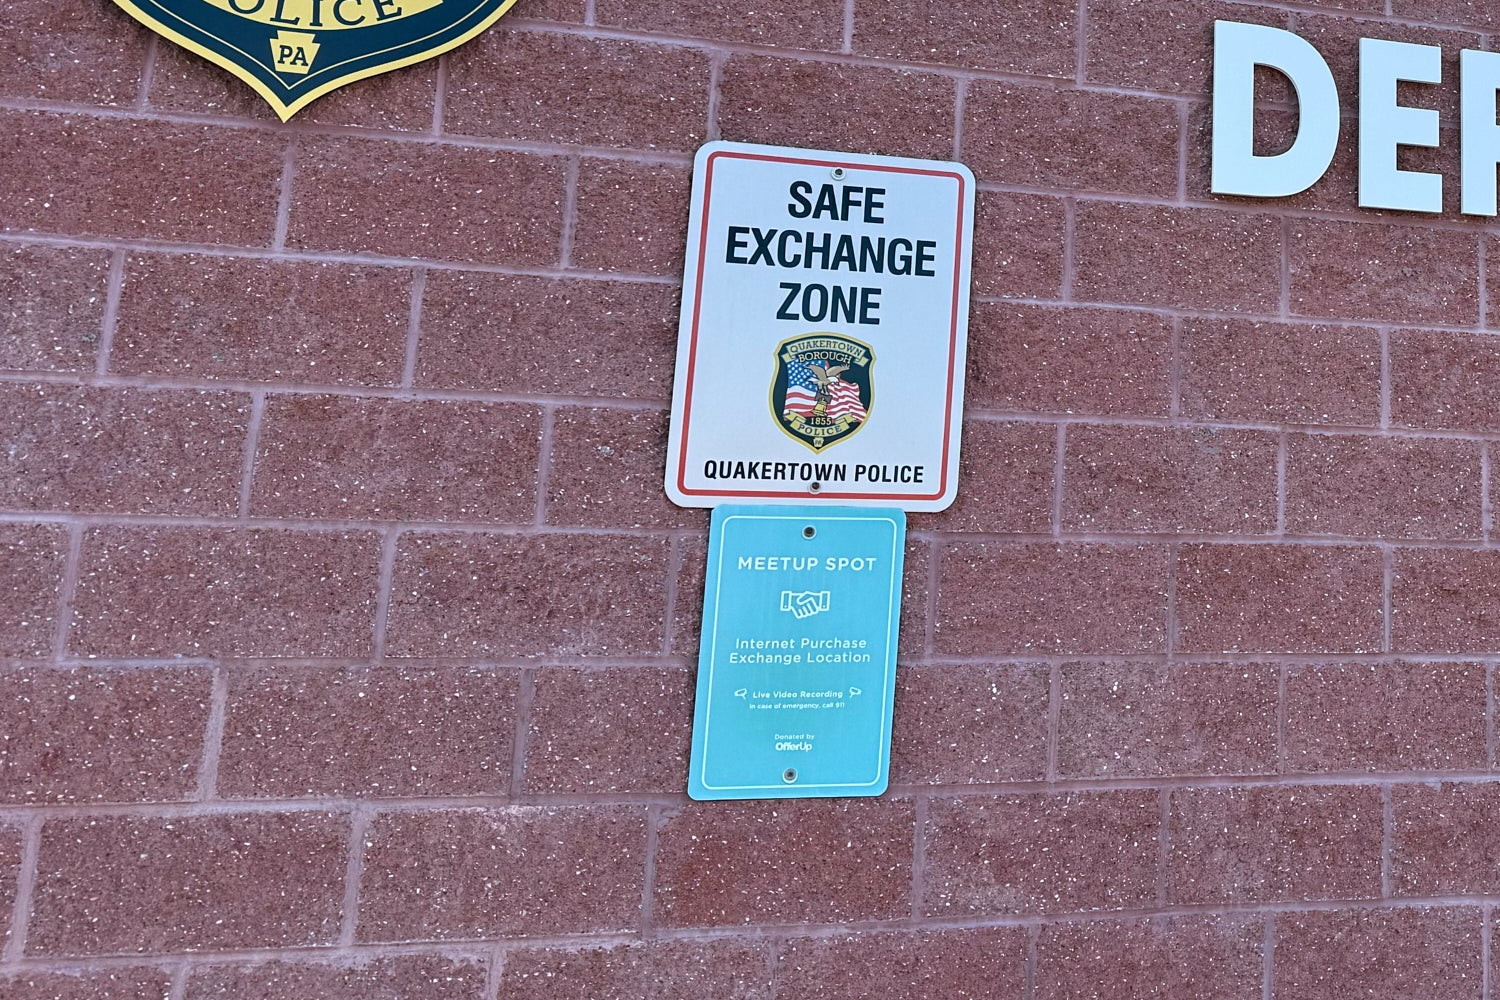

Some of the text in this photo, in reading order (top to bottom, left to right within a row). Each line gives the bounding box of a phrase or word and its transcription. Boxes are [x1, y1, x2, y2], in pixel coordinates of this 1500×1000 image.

[277, 43, 310, 68] PA
[787, 180, 886, 224] SAFE
[725, 225, 937, 278] EXCHANGE
[776, 281, 882, 326] ZONE
[789, 339, 864, 358] QUAKERTOWN
[798, 350, 853, 364] BOROUGH
[811, 417, 832, 426] 1855
[797, 424, 842, 436] POLICE
[704, 460, 924, 484] QUAKERTOWN POLICE
[738, 556, 877, 571] MEETUP SPOT
[735, 637, 867, 650] Internet Purchase
[729, 651, 871, 666] Exchange Location
[752, 690, 843, 699] Live Video Recording
[806, 733, 815, 741] by
[775, 742, 812, 752] OfferUp
